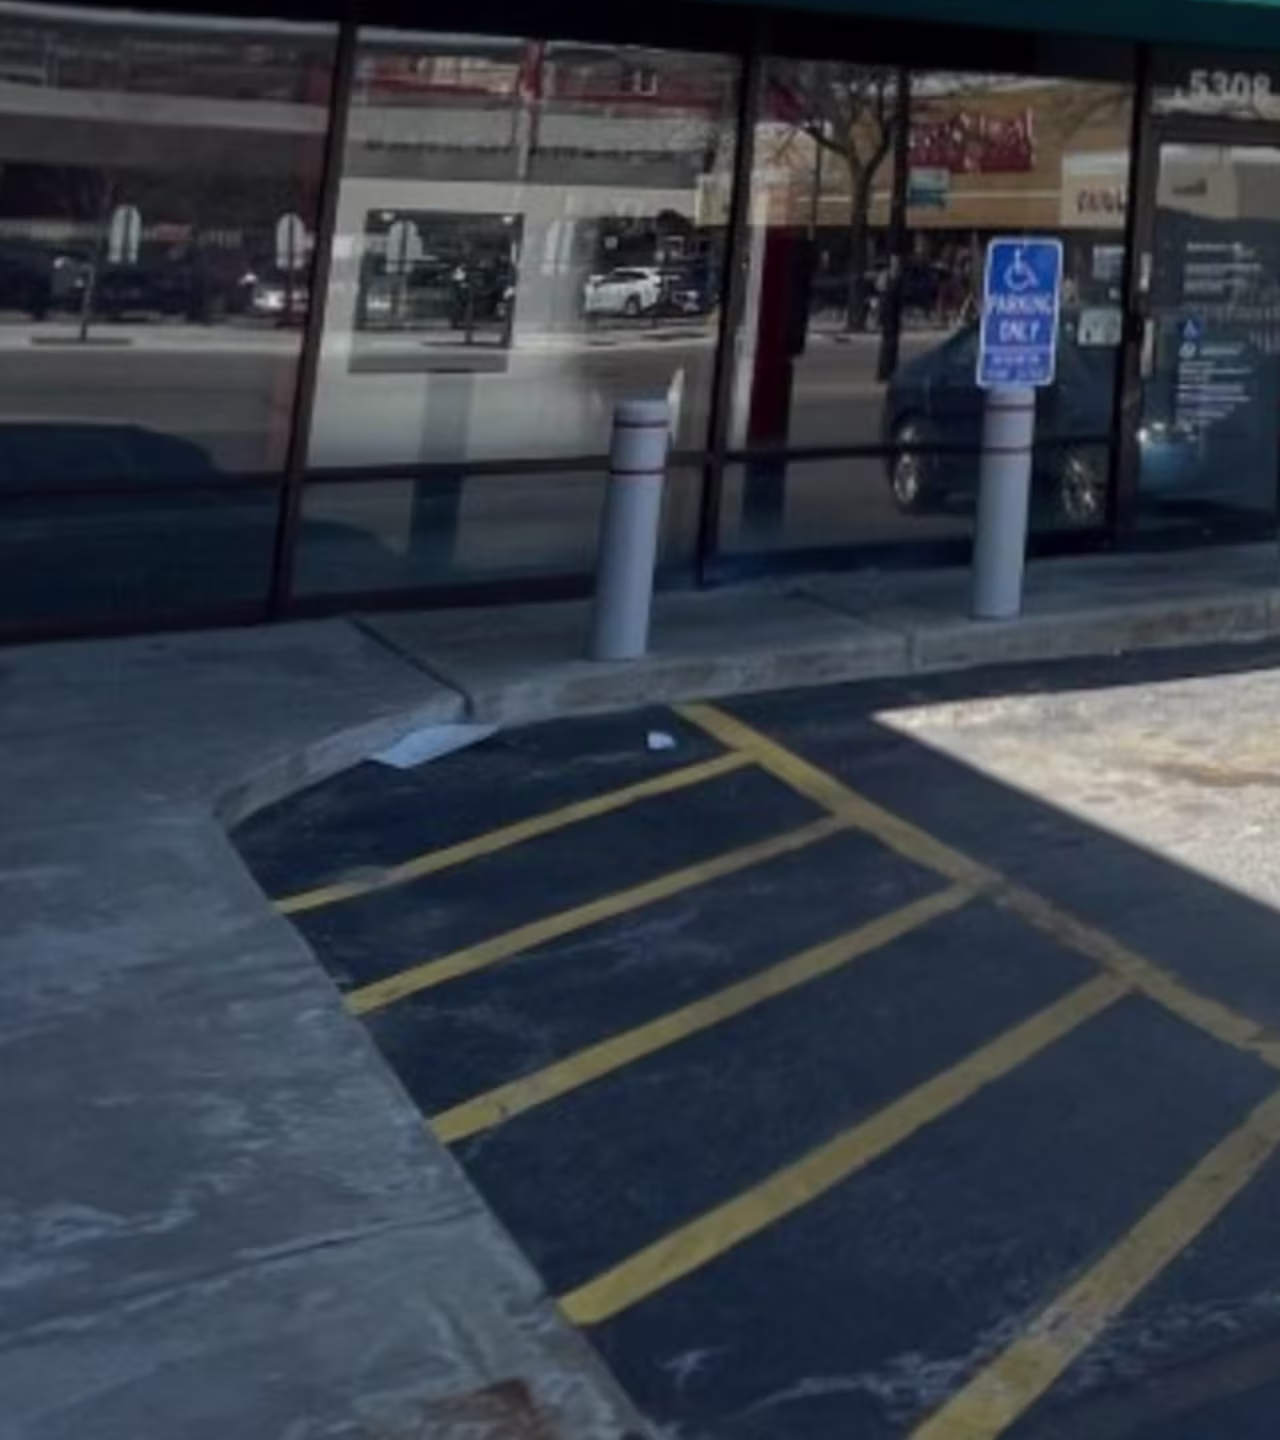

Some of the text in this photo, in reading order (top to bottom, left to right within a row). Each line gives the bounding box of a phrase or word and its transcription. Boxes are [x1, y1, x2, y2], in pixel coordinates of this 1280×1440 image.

[1190, 70, 1271, 102] 5308
[990, 293, 1053, 315] PARKING
[998, 318, 1041, 343] ONLY
